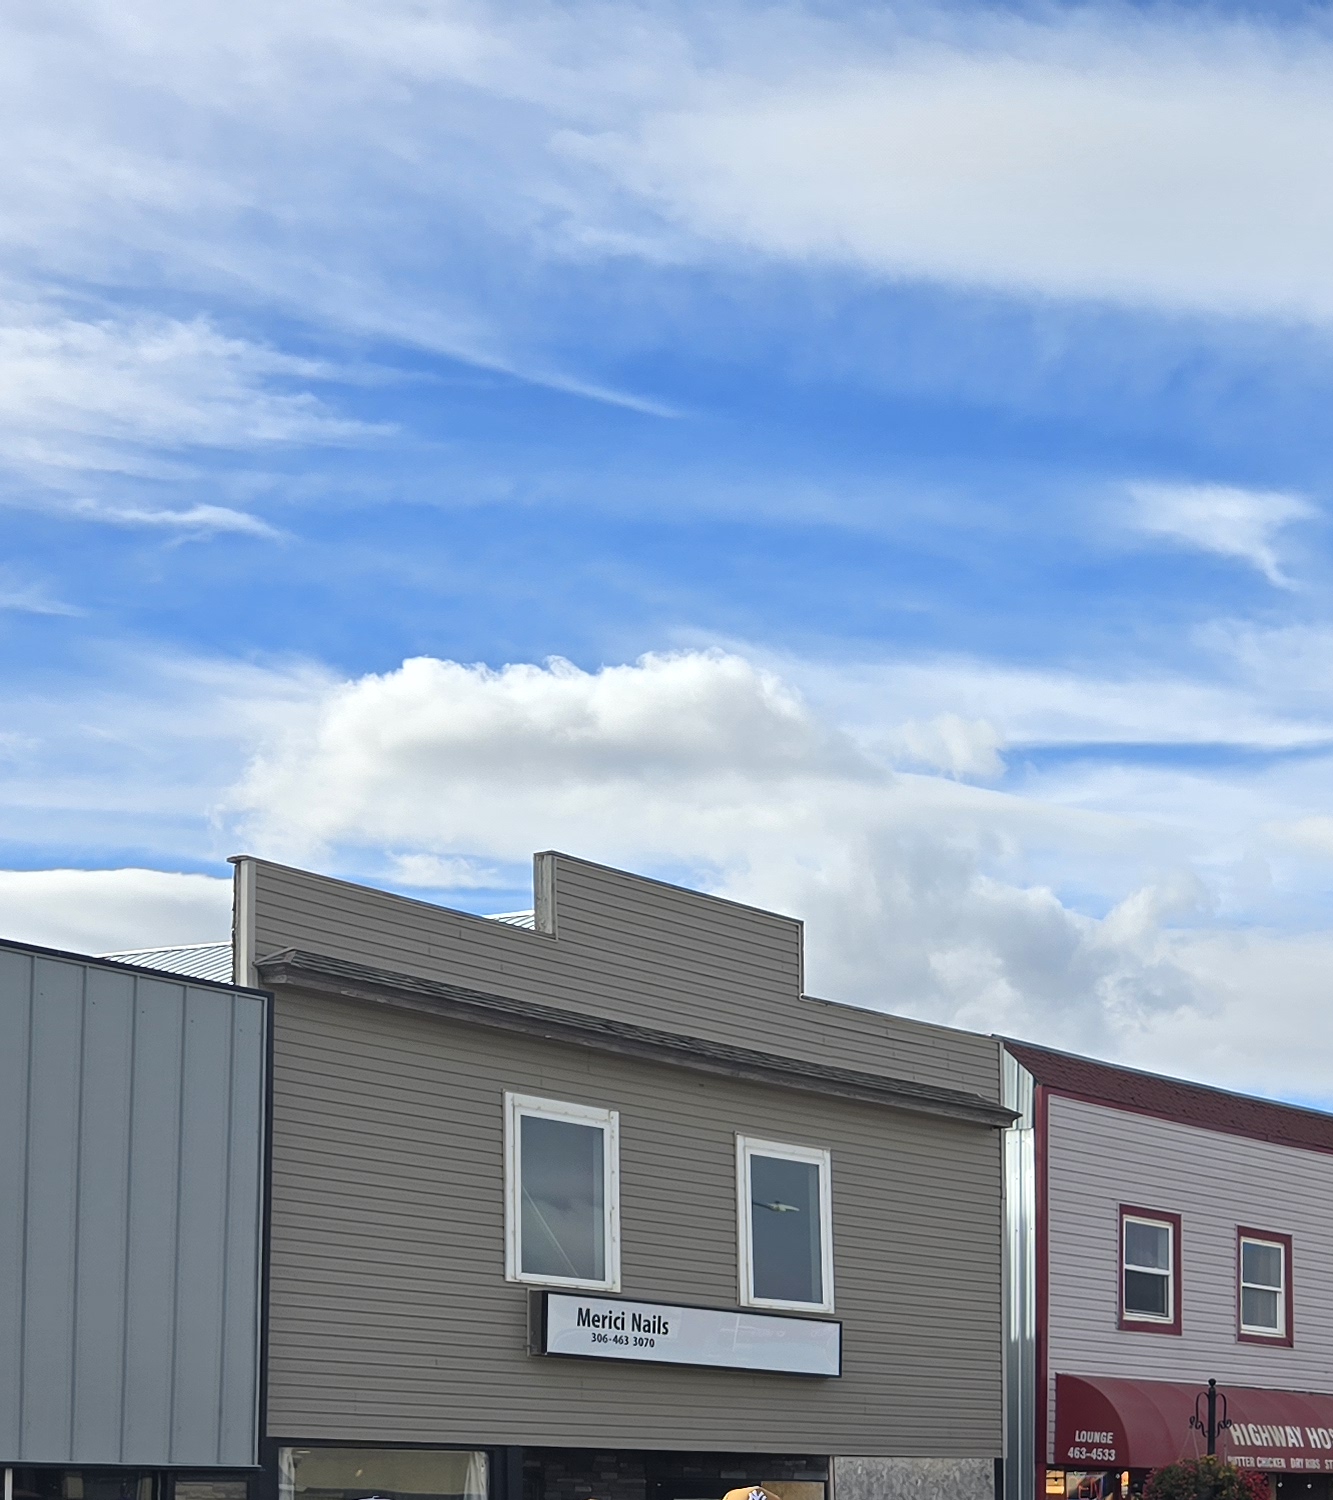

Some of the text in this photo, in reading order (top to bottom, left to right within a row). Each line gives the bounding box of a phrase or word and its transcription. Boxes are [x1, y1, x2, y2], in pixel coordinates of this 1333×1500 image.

[577, 1307, 669, 1335] Merici Nails
[633, 1336, 655, 1348] 3070
[1075, 1430, 1114, 1444] LOUNGE
[1229, 1423, 1304, 1448] HIGHWAY
[1067, 1447, 1116, 1461] 463-4533
[1257, 1457, 1287, 1469] CHICKEN
[1290, 1457, 1304, 1469] DRY
